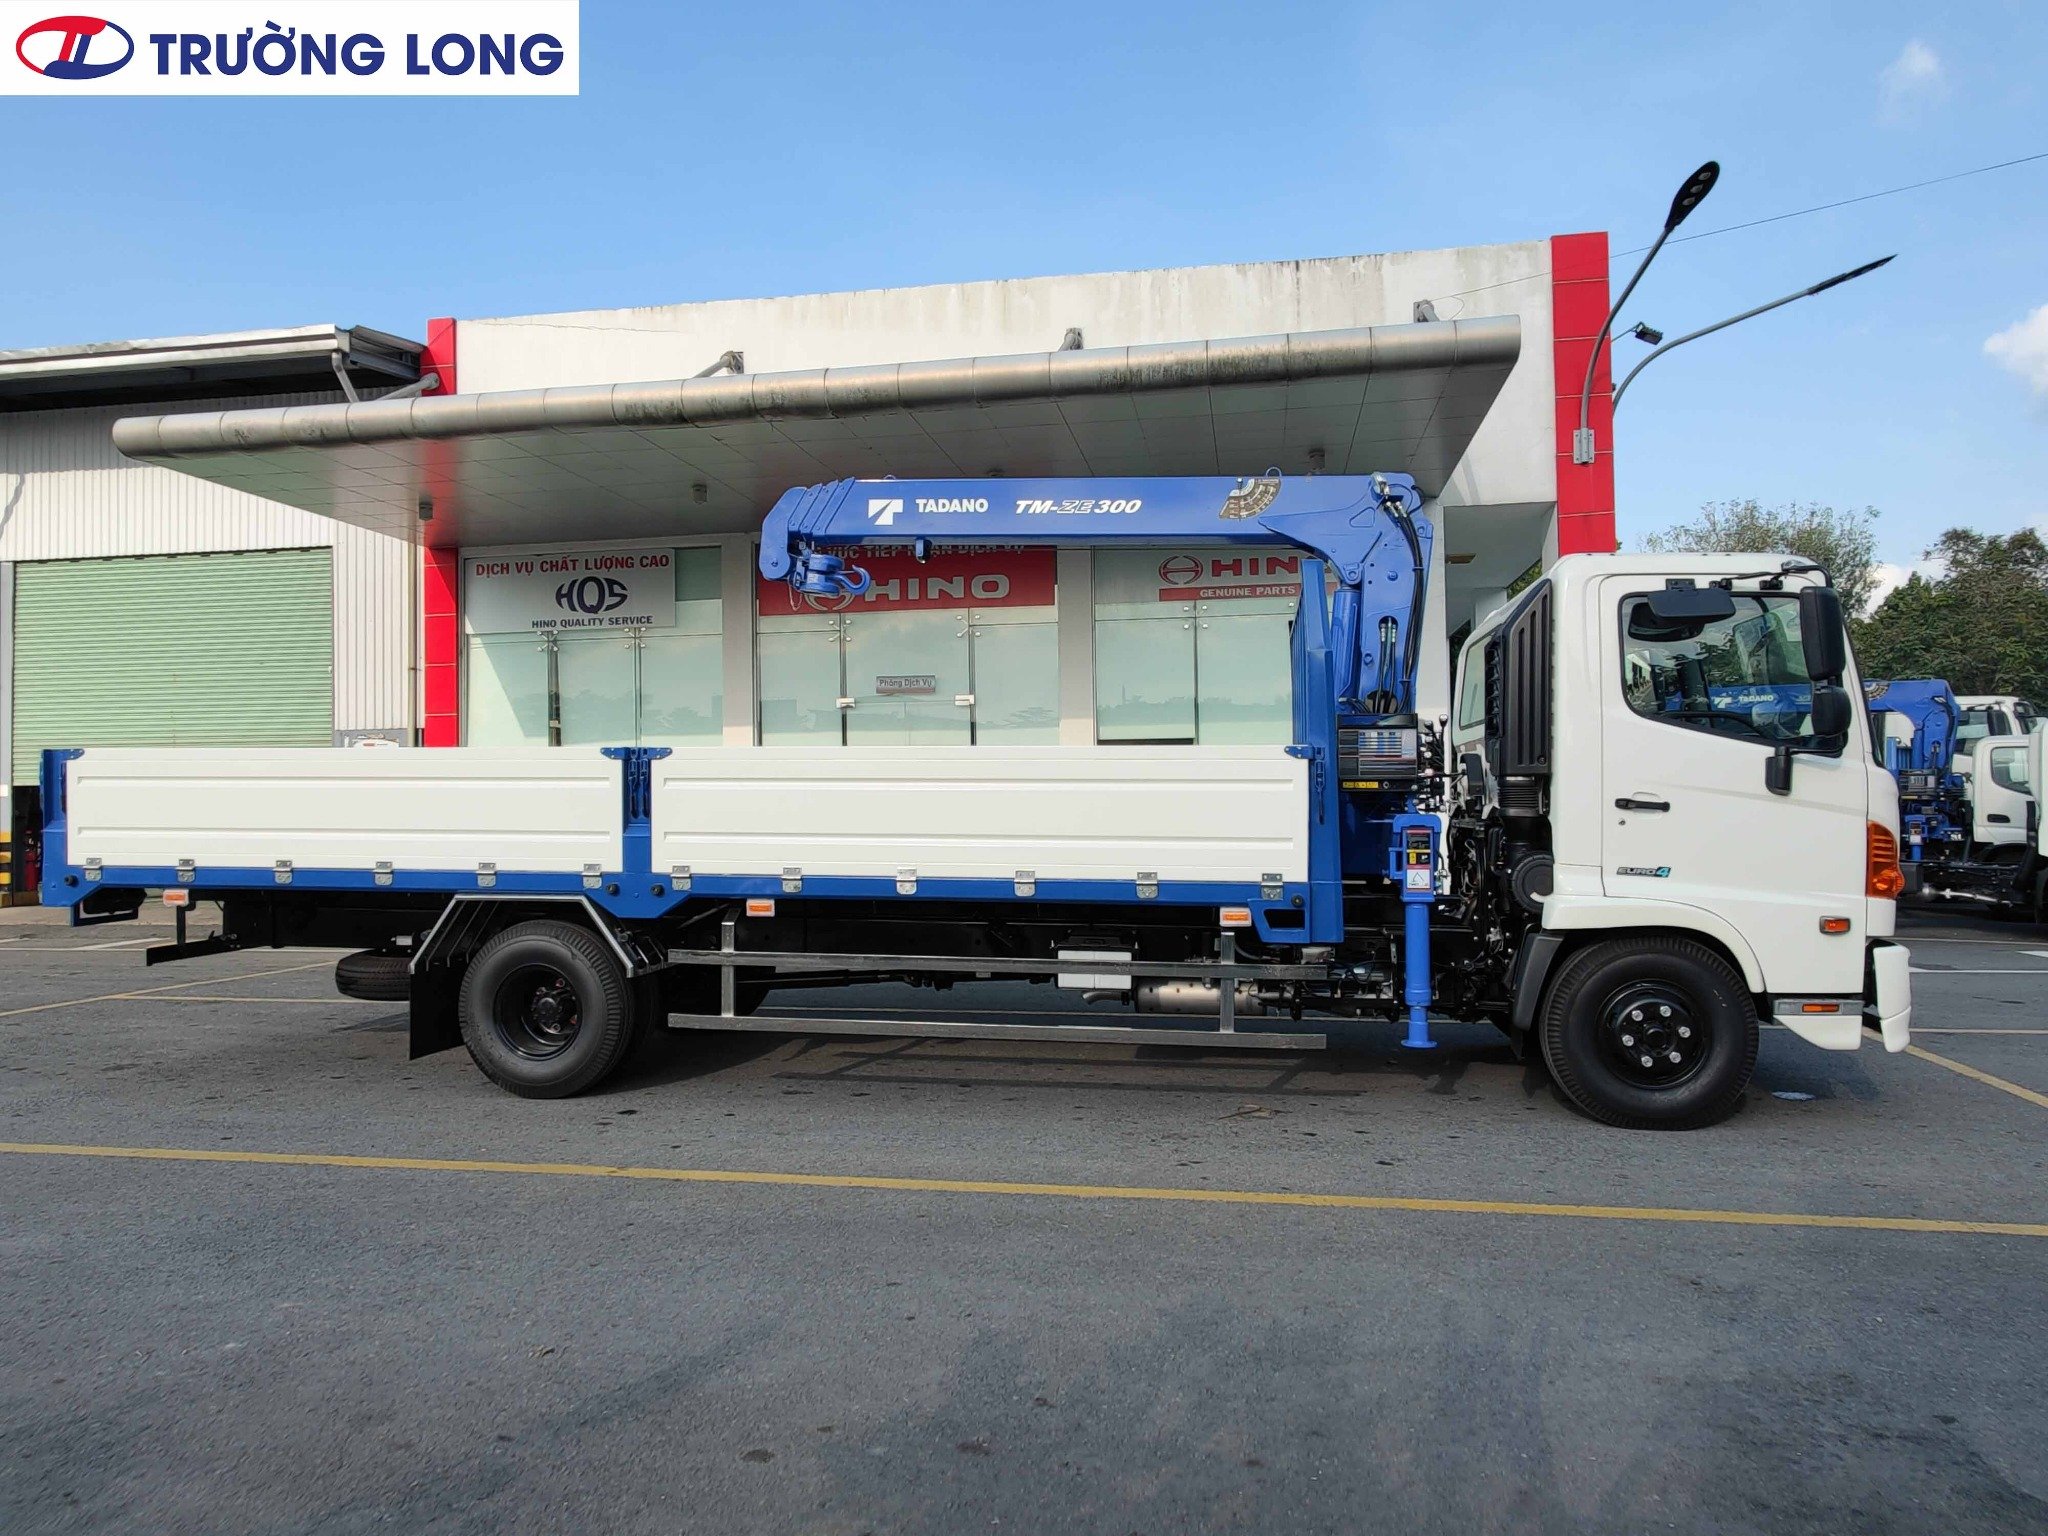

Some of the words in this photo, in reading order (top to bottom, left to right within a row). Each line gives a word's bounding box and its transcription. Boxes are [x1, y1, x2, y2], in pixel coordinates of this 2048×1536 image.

[915, 498, 989, 513] TADANO
[475, 562, 510, 579] DỊCH
[514, 560, 534, 576] VỤ
[540, 555, 579, 573] CHẤT
[584, 555, 635, 572] LƯỢNG
[639, 554, 670, 569] CAO
[1211, 556, 1299, 577] HIN
[555, 576, 628, 614] HQS
[865, 574, 1010, 602] HINO
[1200, 588, 1252, 598] GENUINE
[1256, 585, 1296, 596] PARTS
[531, 619, 557, 629] HINO
[560, 617, 605, 628] QUALITY
[608, 615, 654, 626] SERVICE
